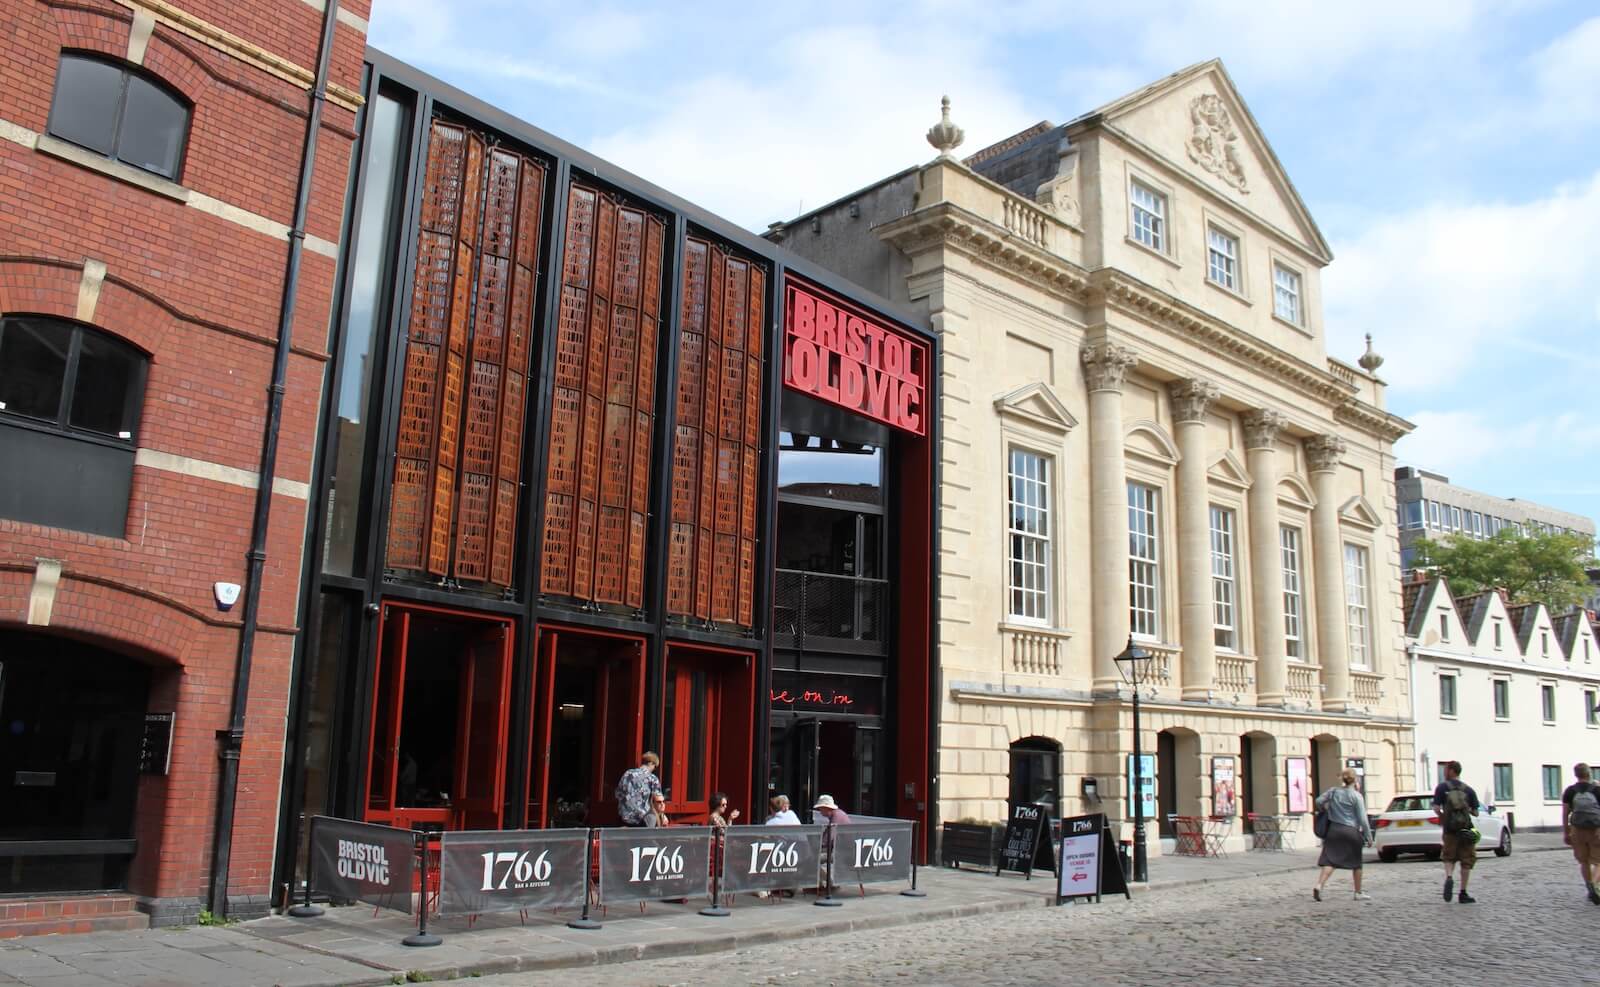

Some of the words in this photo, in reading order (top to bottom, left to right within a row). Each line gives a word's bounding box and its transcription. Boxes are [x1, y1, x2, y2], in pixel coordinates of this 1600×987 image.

[794, 291, 920, 387] BRISTOL
[804, 690, 824, 704] on
[832, 690, 854, 704] in
[1014, 806, 1038, 818] 1766
[1072, 820, 1092, 832] 1766
[338, 839, 389, 865] BRISTOL
[629, 845, 684, 882] 1766
[748, 841, 799, 874] 1766
[854, 837, 893, 868] 1766
[480, 849, 552, 891] 1766
